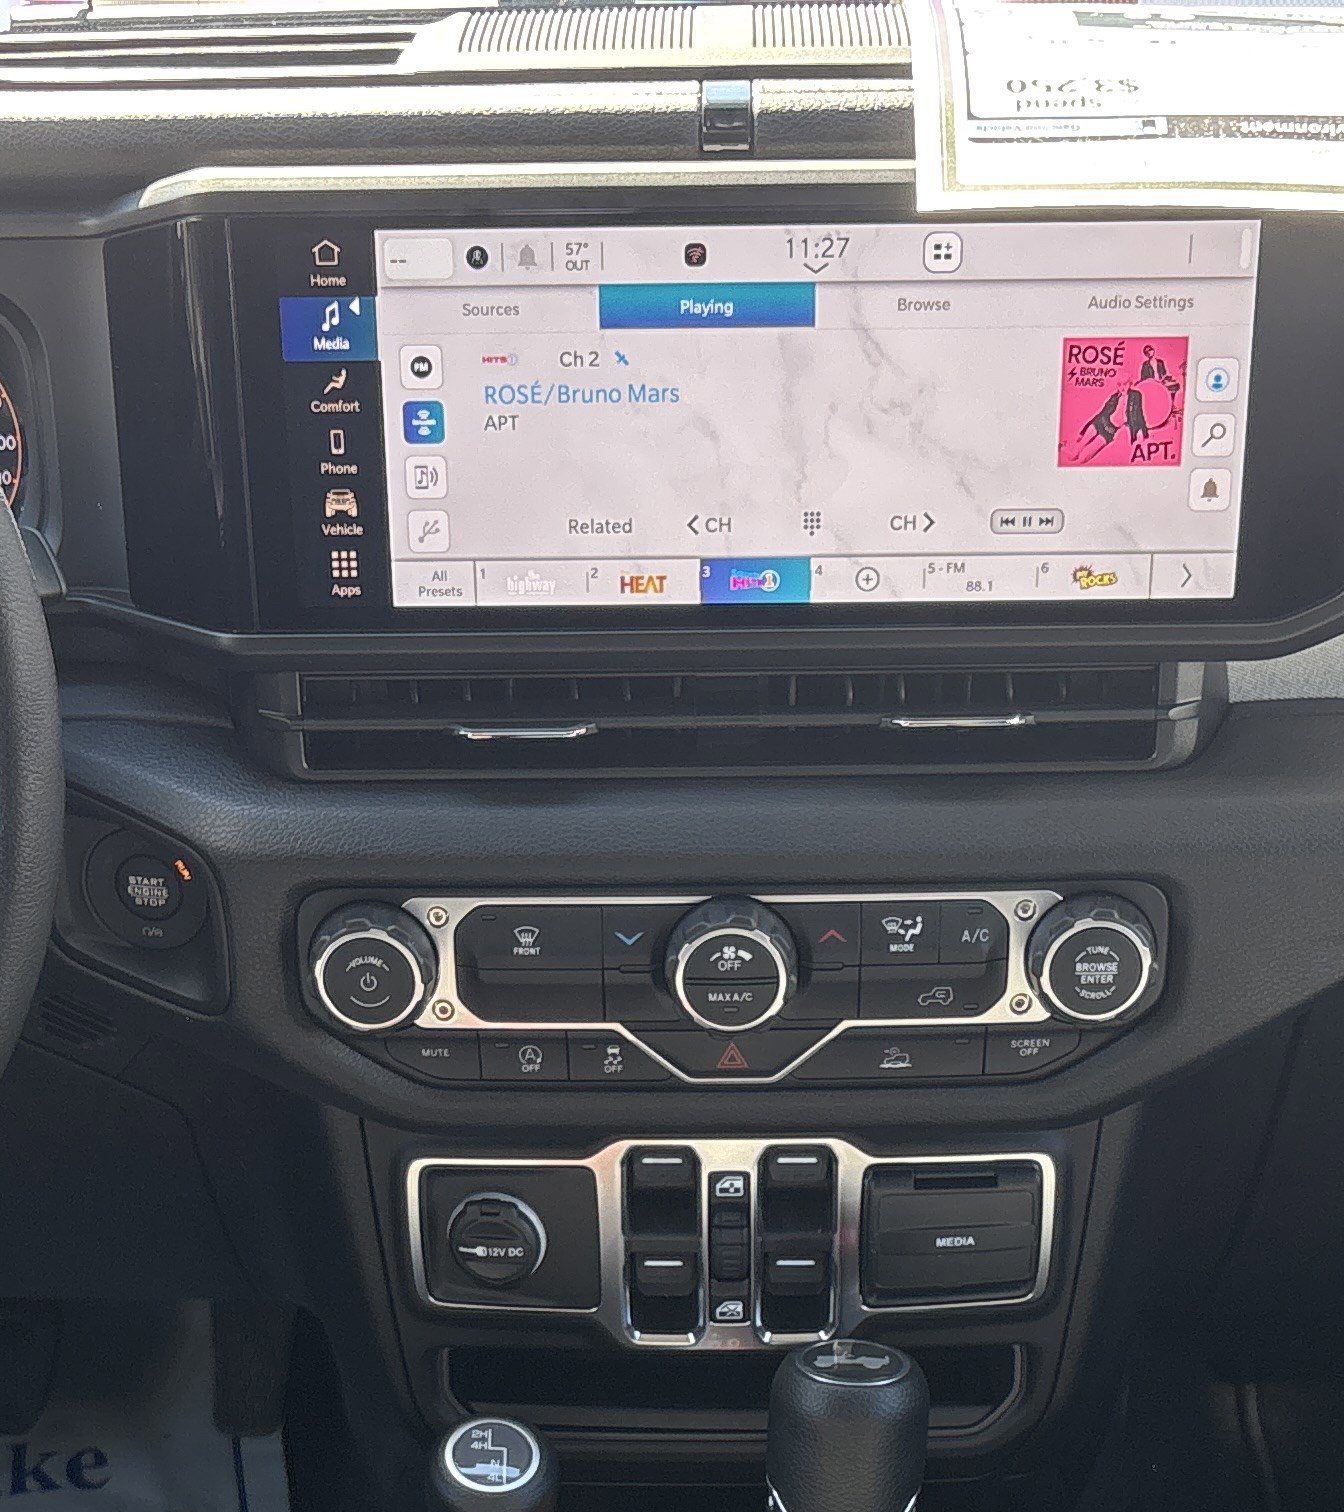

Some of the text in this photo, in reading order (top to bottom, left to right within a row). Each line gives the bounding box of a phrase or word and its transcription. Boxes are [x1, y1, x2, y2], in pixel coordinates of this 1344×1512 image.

[565, 242, 589, 257] 57°
[785, 237, 850, 259] 11:27
[565, 258, 590, 271] OUT
[310, 274, 347, 287] Home
[680, 298, 734, 318] Playing
[897, 296, 951, 312] Browse
[1088, 294, 1195, 312] Audio Settings
[462, 303, 520, 317] Sources
[313, 336, 350, 351] Media
[559, 351, 600, 368] Ch 2
[1067, 341, 1126, 366] ROSÉ
[1079, 366, 1118, 378] BRUNO
[1074, 377, 1105, 388] MARS
[628, 382, 680, 403] Mars
[310, 400, 361, 414] Comfort
[484, 414, 519, 431] APT
[1130, 440, 1176, 463] APT.
[320, 461, 358, 476] Phone
[321, 522, 364, 537] Vehicle
[568, 517, 633, 534] Related
[704, 517, 732, 534] CH
[889, 514, 918, 532] CH
[590, 567, 599, 579] 2
[701, 566, 711, 579] 3
[814, 565, 823, 577] 4
[927, 562, 966, 575] 5 FM
[1040, 562, 1050, 574] 6
[431, 570, 448, 582] All
[1080, 572, 1118, 589] ROCKS
[506, 576, 556, 596] highway
[620, 574, 668, 594] HEAT
[965, 580, 993, 592] 88.1
[331, 584, 362, 598] Apps
[418, 585, 463, 599] Presets
[175, 859, 192, 880] RUN
[128, 875, 165, 887] START
[127, 885, 169, 898] ENGINE
[135, 897, 166, 907] STOP
[961, 929, 990, 943] A/C
[513, 946, 541, 956] FRONT
[889, 943, 915, 953] MODE
[1086, 945, 1110, 956] TUNE
[349, 956, 383, 968] VOLUME
[718, 959, 742, 972] OFF
[1075, 961, 1119, 972] BROWSE
[1080, 974, 1114, 985] ENTER
[707, 991, 753, 1002] MAX A/C
[1077, 988, 1114, 1000] SCROLL
[1010, 1037, 1051, 1049] SCREEN
[421, 1047, 450, 1057] MUTE
[1019, 1047, 1039, 1057] OFF
[520, 1062, 541, 1073] OFF
[603, 1063, 624, 1073] OFF
[935, 1235, 975, 1248] MEDIA
[487, 1247, 525, 1258] 12V DC
[471, 1428, 488, 1439] 2H
[470, 1441, 488, 1450] 4H
